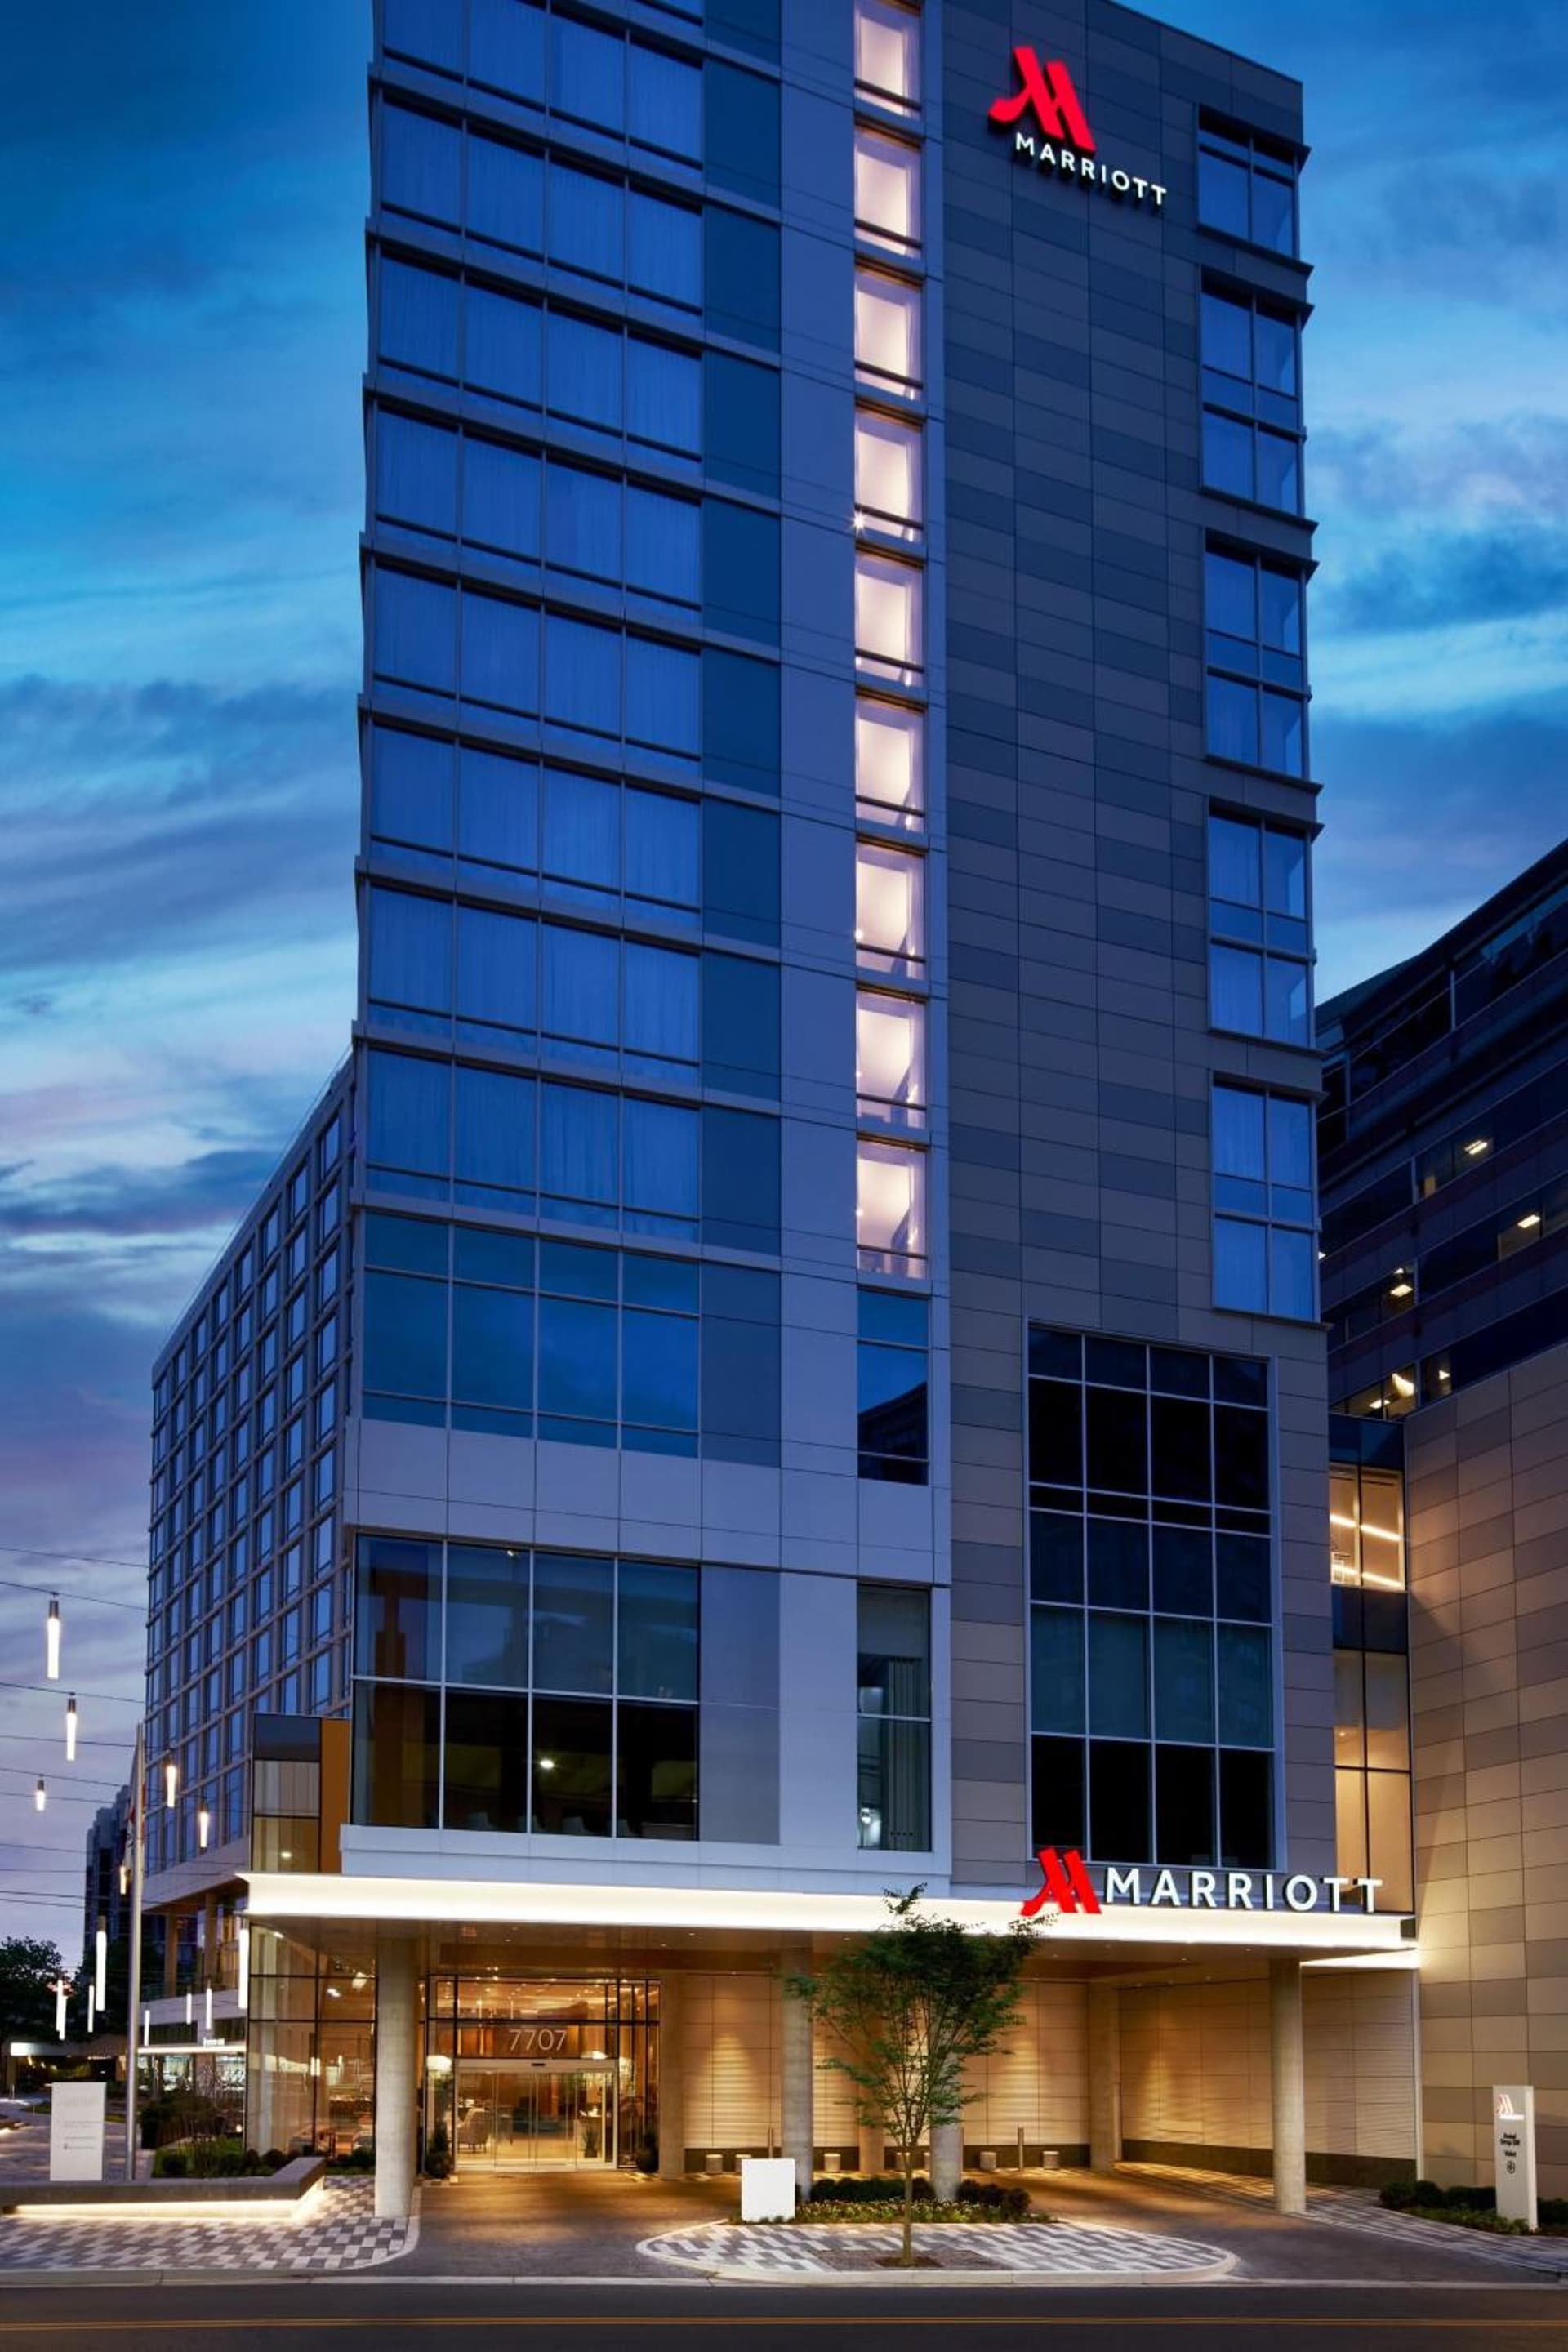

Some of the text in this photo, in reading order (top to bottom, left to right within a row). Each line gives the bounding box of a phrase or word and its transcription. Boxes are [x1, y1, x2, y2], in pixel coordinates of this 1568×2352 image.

[1014, 131, 1167, 206] MARRIOTT
[1105, 1866, 1383, 1913] MARRIOTT
[508, 2029, 568, 2051] 7707
